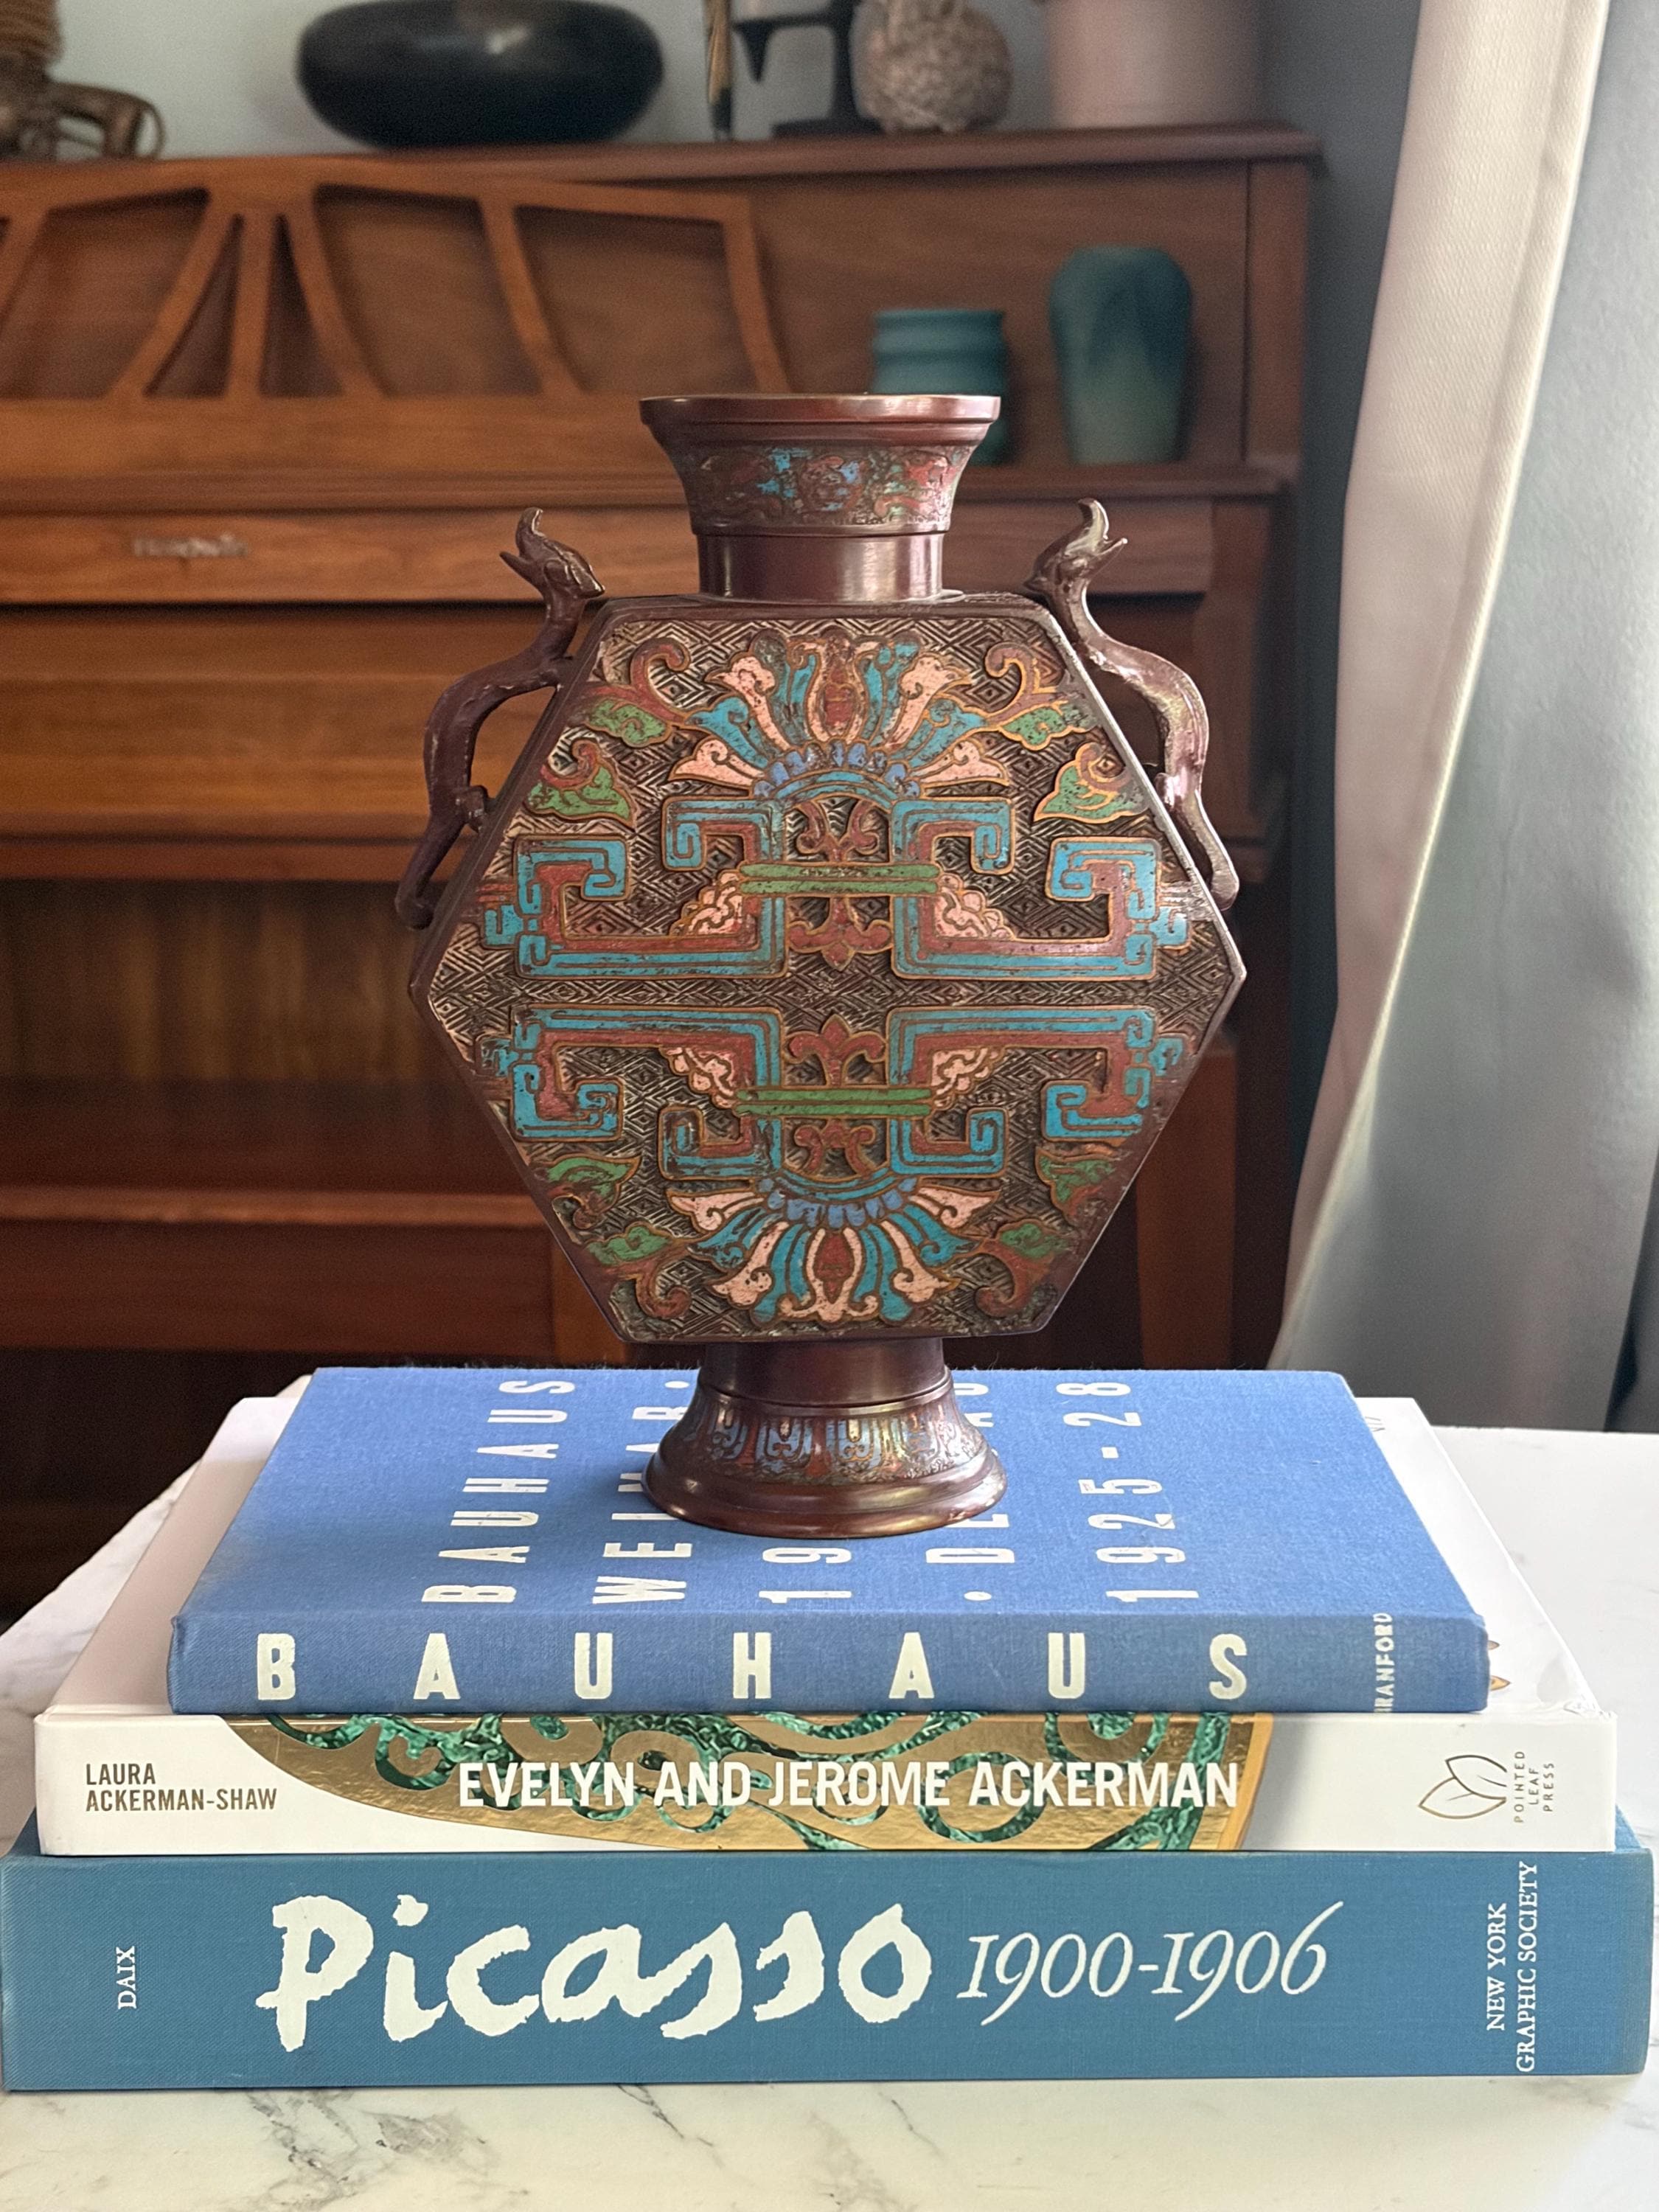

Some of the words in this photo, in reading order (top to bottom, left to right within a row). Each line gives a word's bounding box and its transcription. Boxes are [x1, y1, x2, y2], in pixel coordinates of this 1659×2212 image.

[422, 1380, 575, 1604] BAUHAUS
[592, 1381, 693, 1604] WEIR.
[1056, 1381, 1199, 1602] 1925-28
[257, 1631, 1248, 1701] BAUHAUS
[85, 1763, 156, 1786] LAURA
[85, 1787, 277, 1812] ACKERMAN-SHAW
[459, 1761, 636, 1808] EVELYN
[653, 1761, 752, 1806] AND
[768, 1761, 951, 1808] JEROME
[968, 1761, 1239, 1808] ACKERMAN
[1514, 1750, 1526, 1823] POINTED
[1528, 1767, 1540, 1806] LEAF
[1543, 1762, 1554, 1812] PRESS
[1486, 1902, 1506, 1970] YORK
[1517, 1861, 1537, 1962] SOCIETY
[116, 1946, 139, 2010] DAIX
[256, 1893, 932, 2053] Picasso
[956, 1901, 1343, 2026] 1900-1906
[1486, 1976, 1506, 2031] NEW
[1516, 1969, 1536, 2072] GRAPHIC
